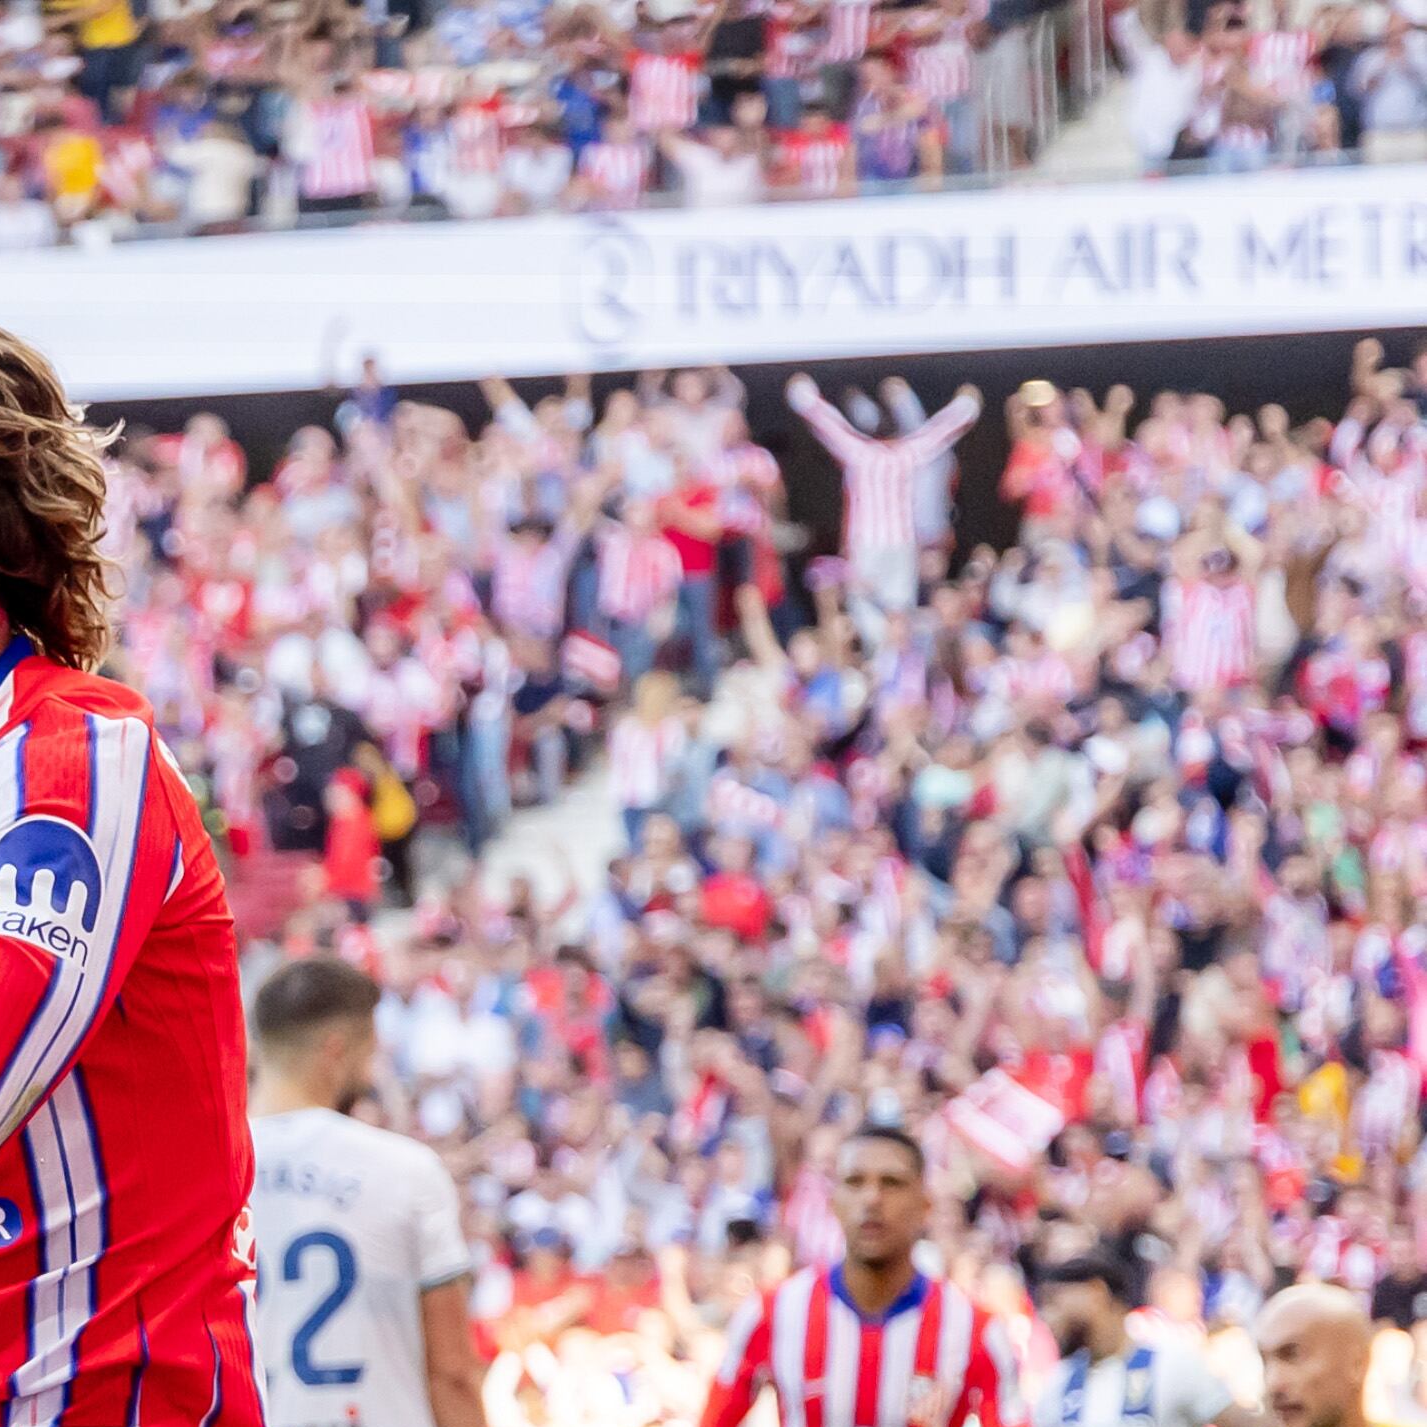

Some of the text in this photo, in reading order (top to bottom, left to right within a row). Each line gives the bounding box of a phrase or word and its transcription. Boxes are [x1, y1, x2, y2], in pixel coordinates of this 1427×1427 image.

[678, 226, 1019, 320] RIYADH
[1044, 215, 1203, 296] AIR
[257, 1230, 367, 1387] 2
